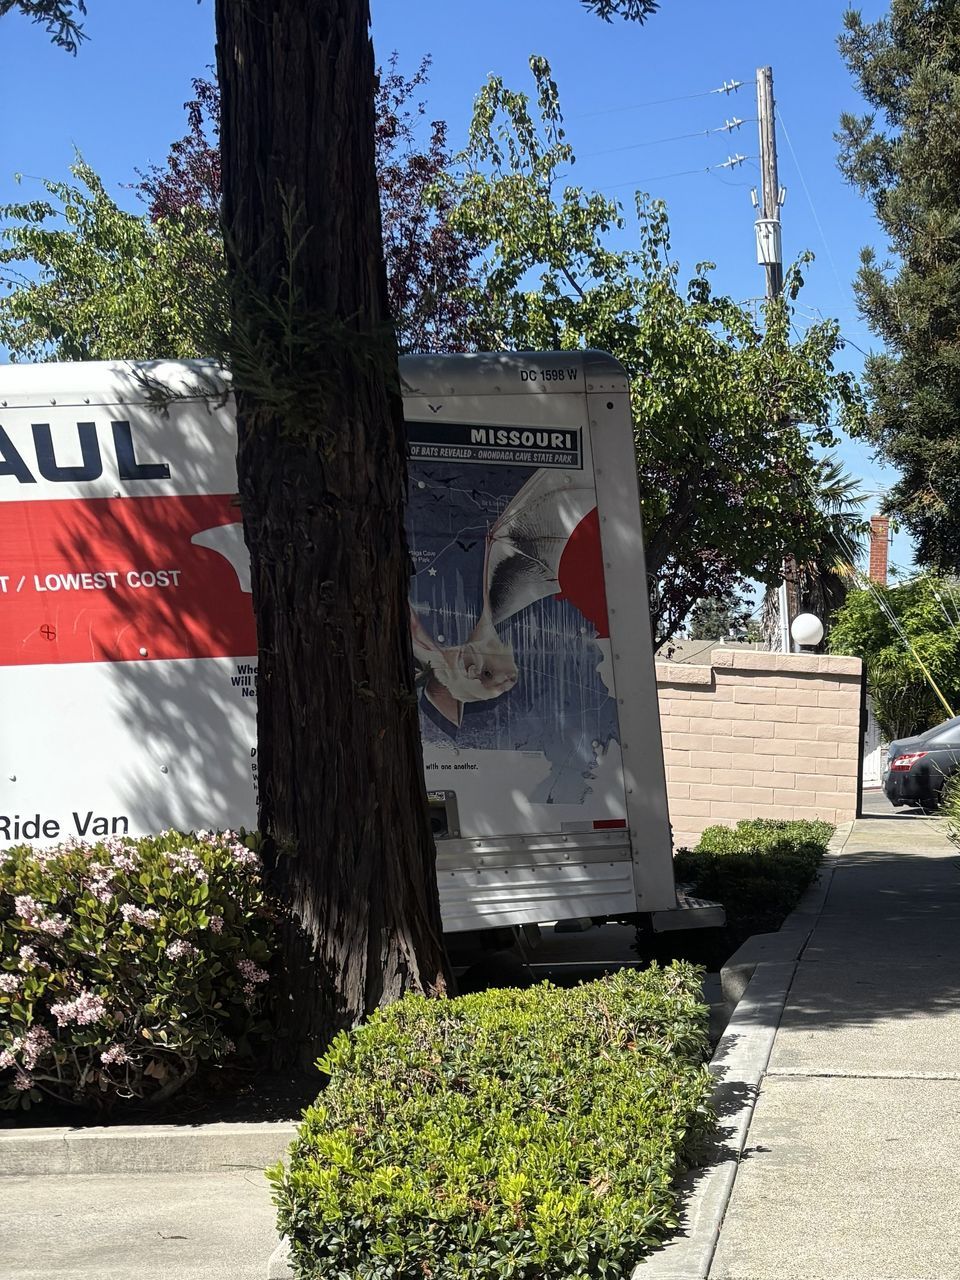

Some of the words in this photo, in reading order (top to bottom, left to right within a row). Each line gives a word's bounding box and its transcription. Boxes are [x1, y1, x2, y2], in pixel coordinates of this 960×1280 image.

[520, 370, 537, 381] DC
[540, 369, 565, 381] 1598
[567, 368, 577, 380] W
[470, 429, 572, 448] MISSOURI
[411, 446, 420, 455] OF
[421, 447, 439, 457] BATS
[439, 448, 472, 458] REVEALED
[478, 450, 513, 461] ONONDAGA
[515, 452, 532, 462] CAVE
[533, 453, 553, 463] STATE
[554, 454, 572, 463] PARK
[34, 572, 118, 592] LOWEST
[126, 570, 181, 588] COST
[231, 675, 251, 686] Will
[425, 762, 439, 770] with
[453, 762, 479, 770] another.
[72, 811, 129, 836] Van
